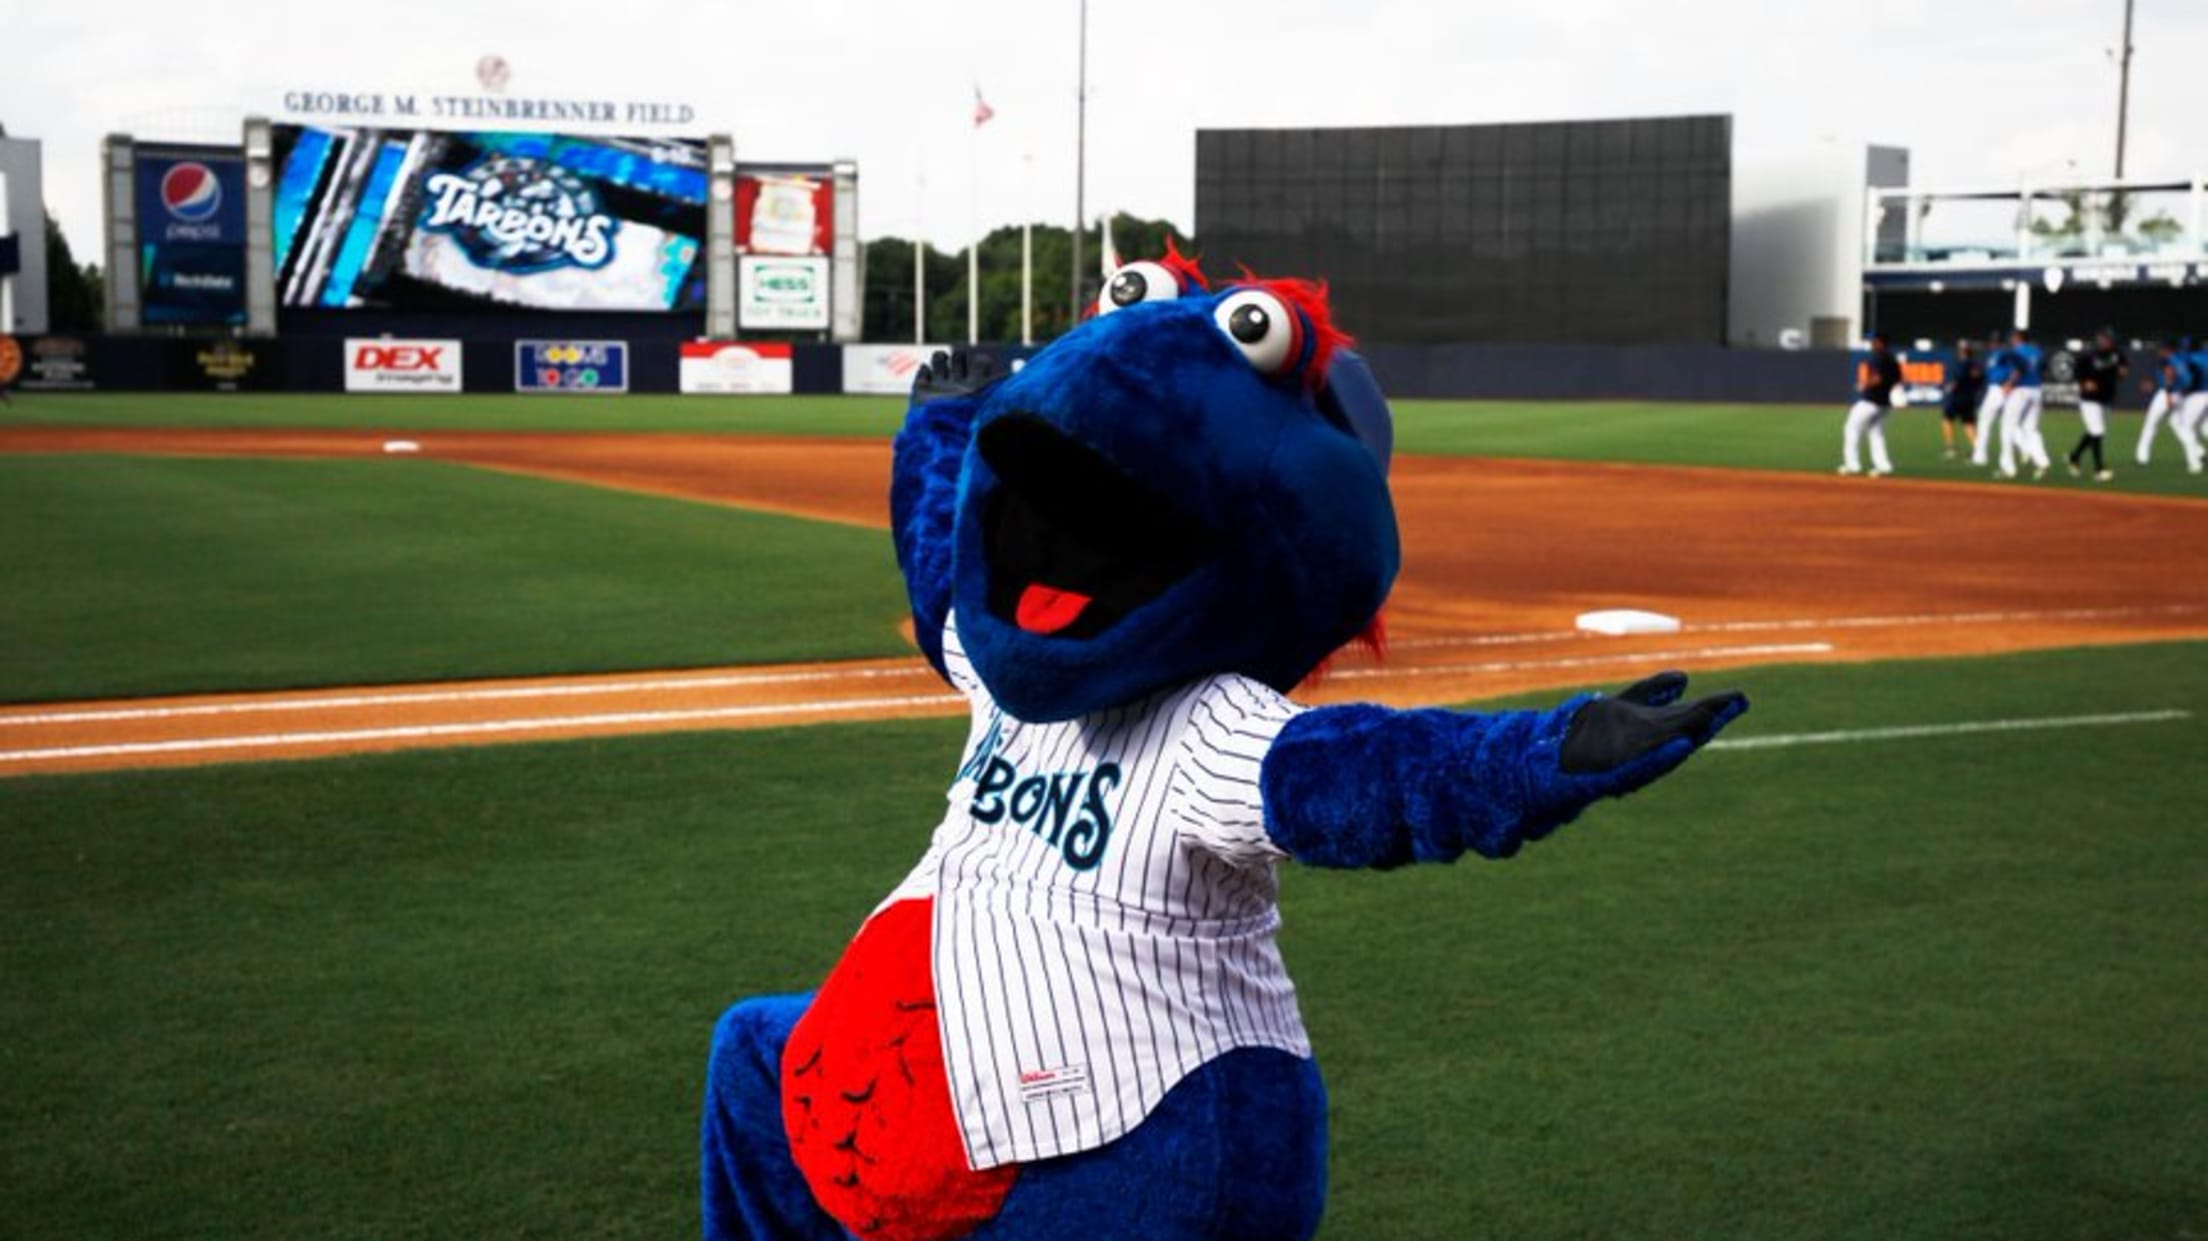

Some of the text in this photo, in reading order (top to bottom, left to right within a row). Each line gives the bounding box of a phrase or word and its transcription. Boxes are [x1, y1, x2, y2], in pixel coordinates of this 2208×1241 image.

[284, 91, 384, 115] GEORGE
[432, 97, 615, 121] STEINBRENNER
[627, 102, 695, 124] FIELD
[759, 277, 809, 291] HESS
[353, 346, 442, 371] DEX
